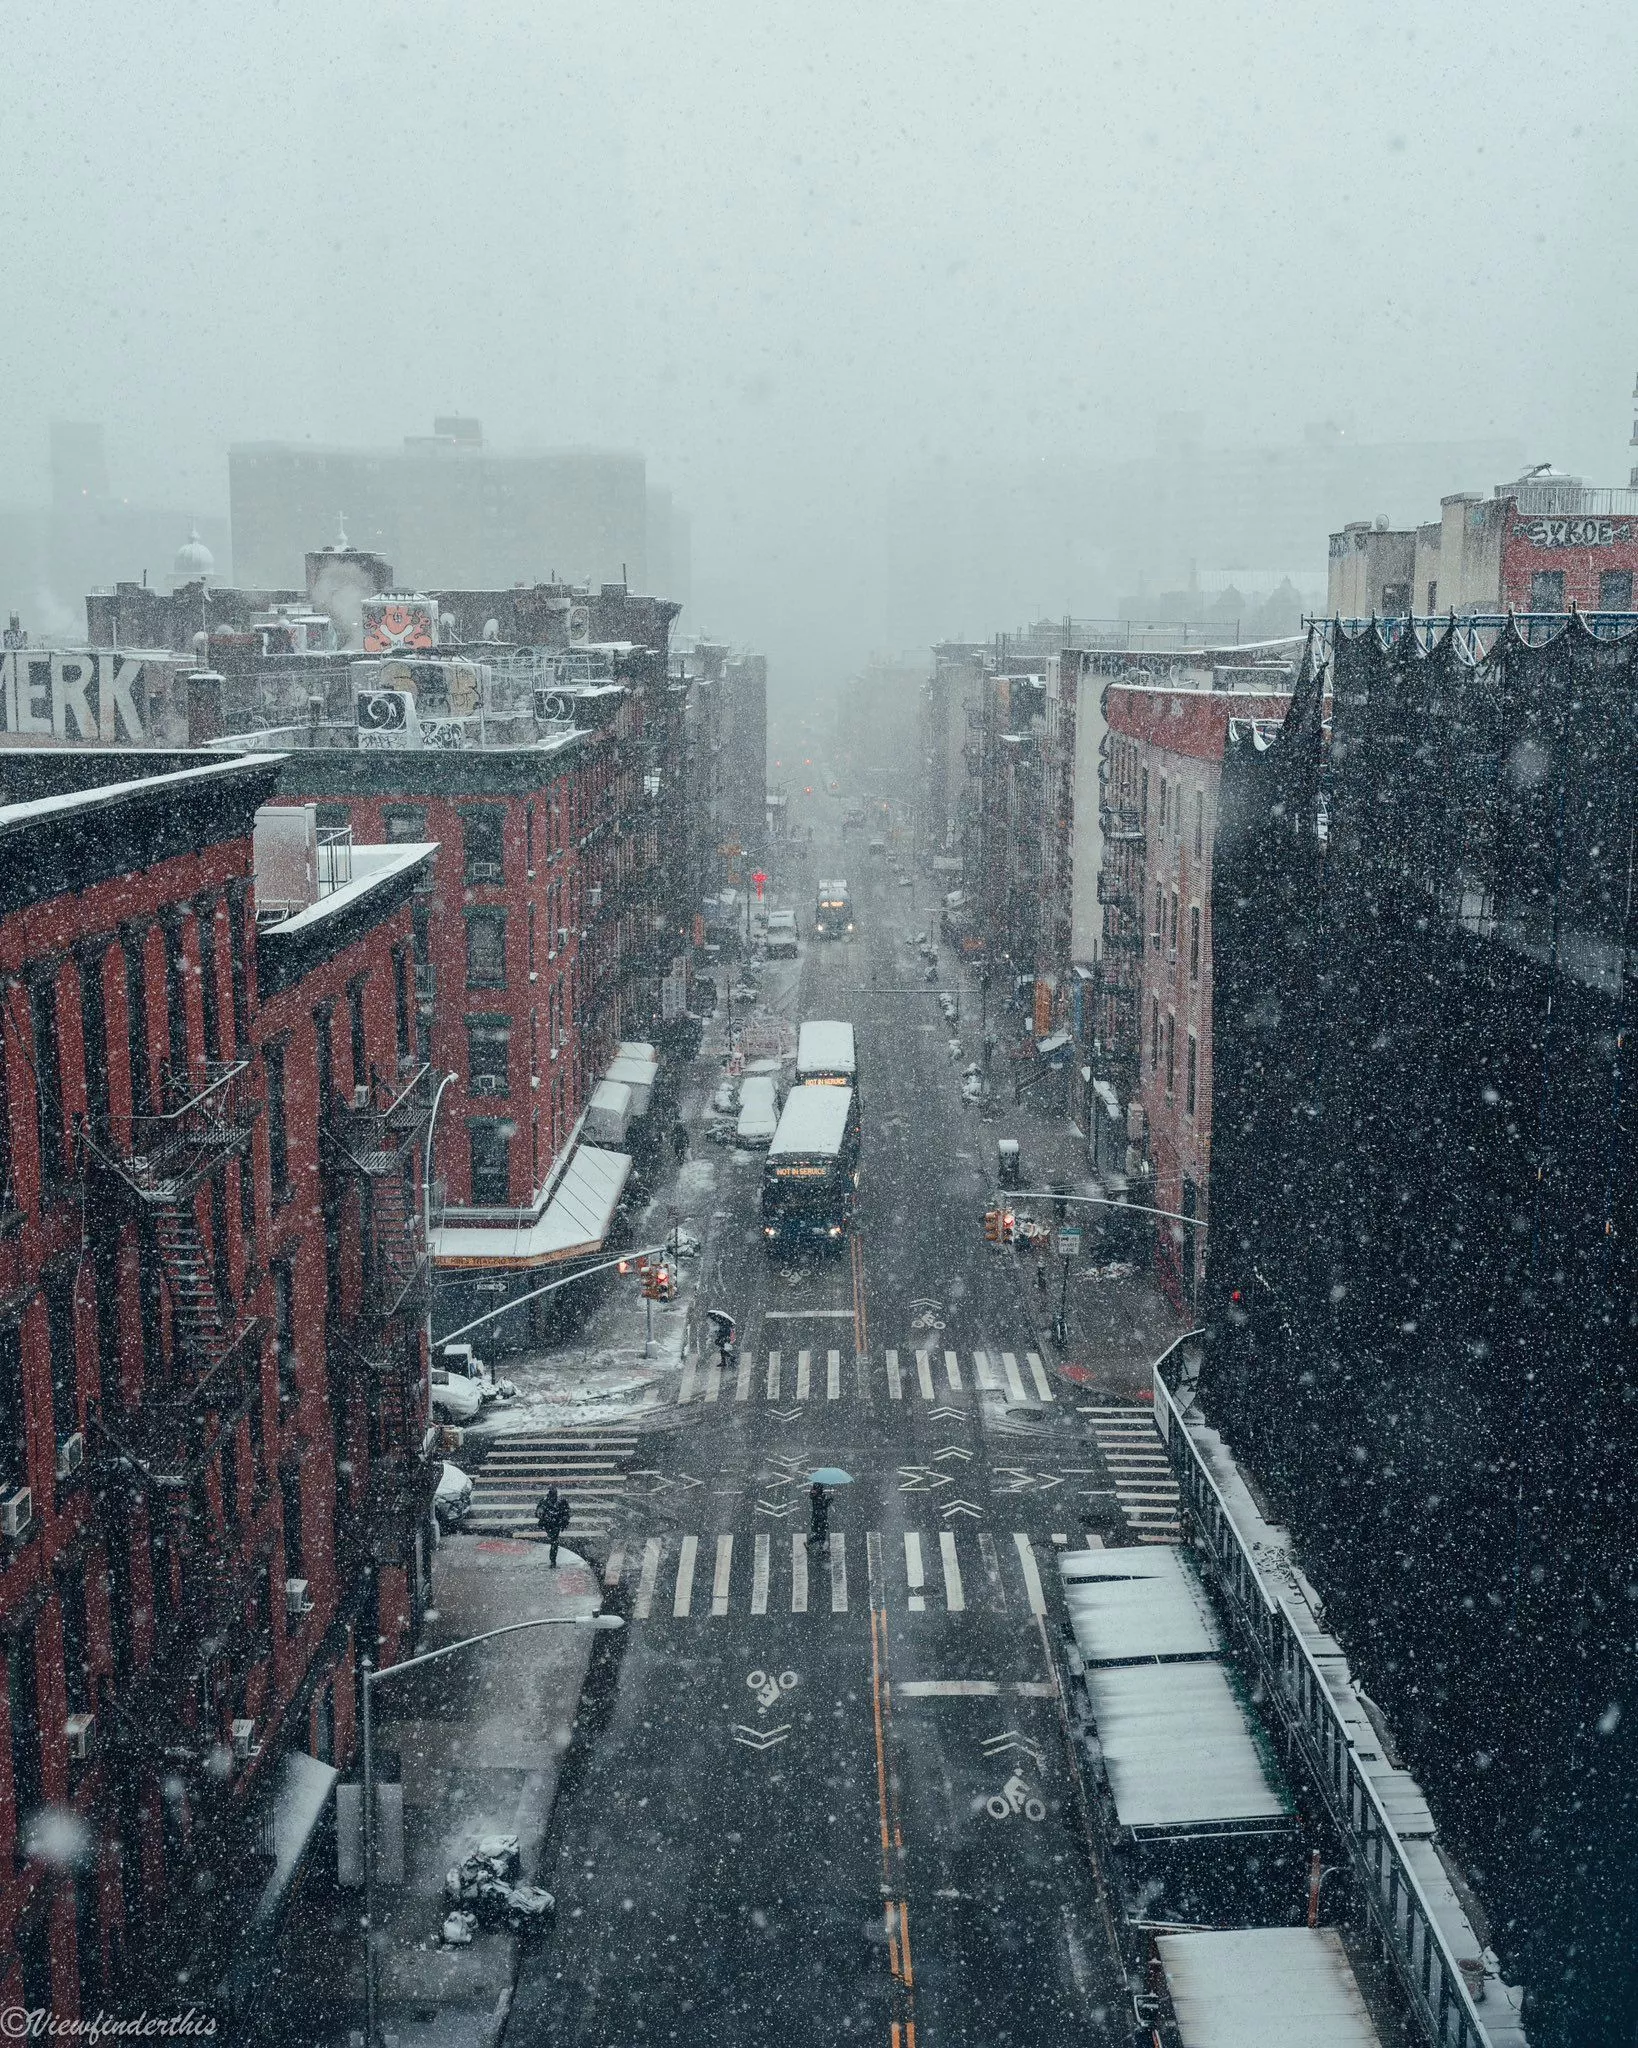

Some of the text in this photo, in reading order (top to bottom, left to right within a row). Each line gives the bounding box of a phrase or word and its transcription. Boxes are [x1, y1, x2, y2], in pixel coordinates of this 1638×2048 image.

[776, 1167, 826, 1176] NOT IN SERVICE
